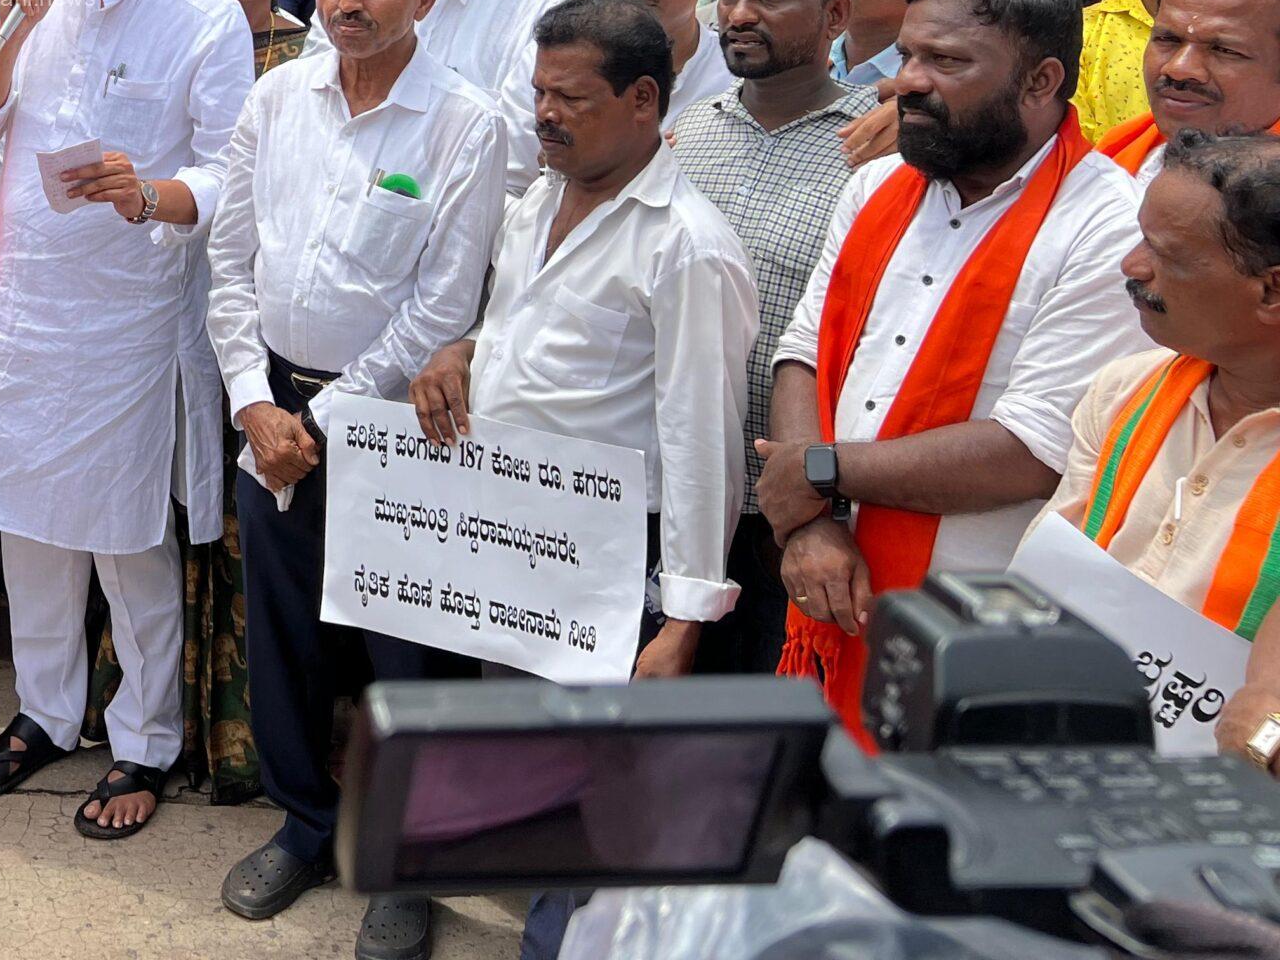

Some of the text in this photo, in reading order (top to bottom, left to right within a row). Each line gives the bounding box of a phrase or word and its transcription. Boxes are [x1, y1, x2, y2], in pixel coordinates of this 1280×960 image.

[459, 440, 484, 471] 187
[491, 445, 531, 483] ಕೋಟಿ
[538, 457, 565, 491] ರೂ.
[573, 464, 622, 502] ಹಗರಣ
[375, 493, 448, 543] ಮುಖ್ಯಮಂತ್ರಿ
[354, 564, 597, 653] ನೈತಿಕ ಹೊಣೆ ಹೊತ್ತು ರಾಜೀನಾಮೆ ನೀಡಿ
